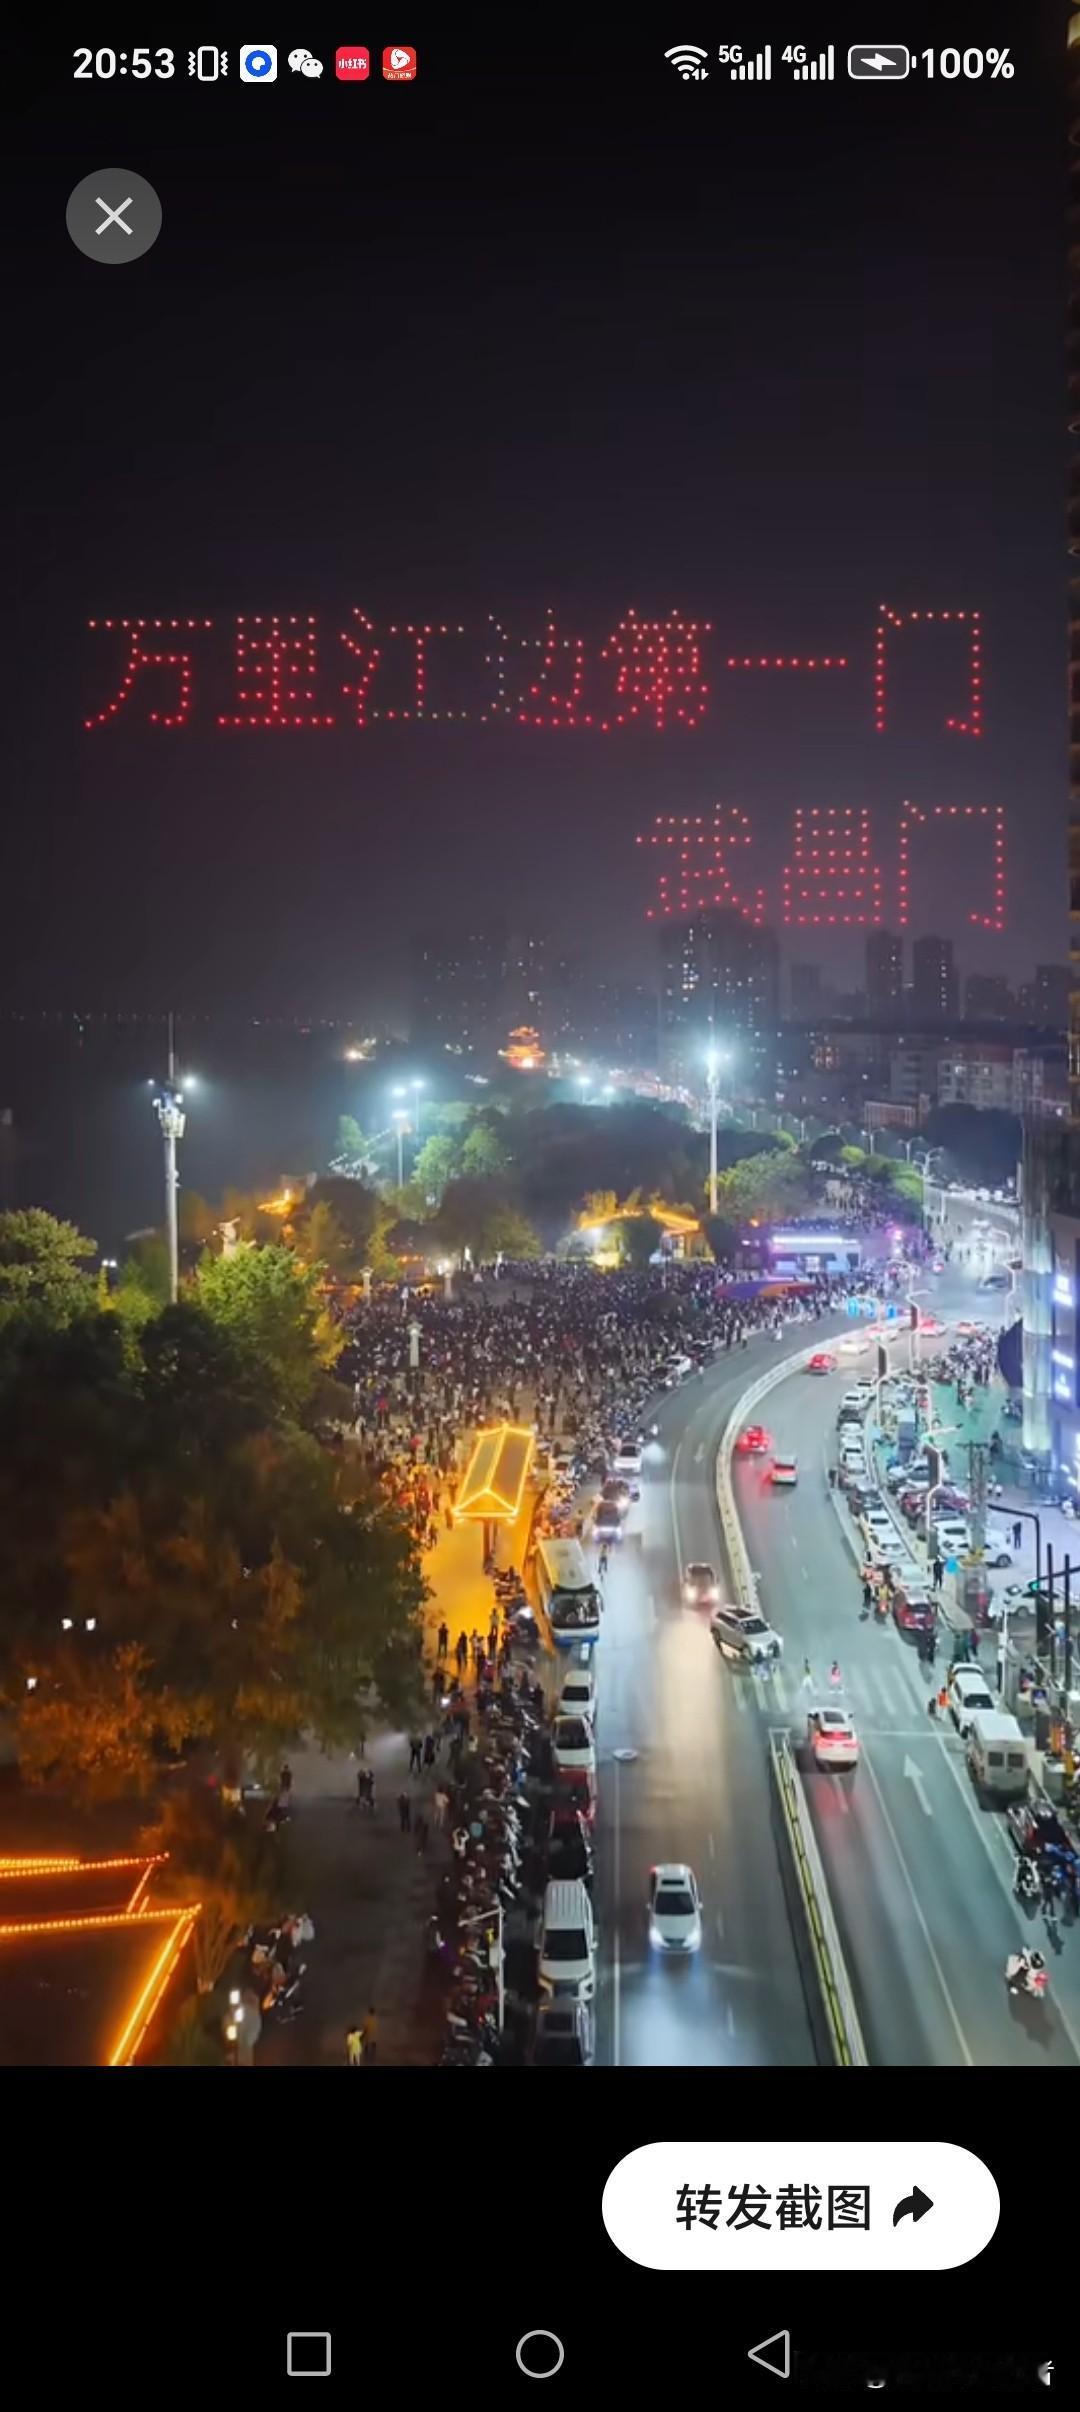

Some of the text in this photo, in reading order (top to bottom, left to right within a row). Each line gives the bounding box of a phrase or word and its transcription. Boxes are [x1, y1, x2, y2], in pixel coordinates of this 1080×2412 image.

[84, 604, 982, 737] 万里江边第一门
[634, 799, 1005, 928] 武昌门
